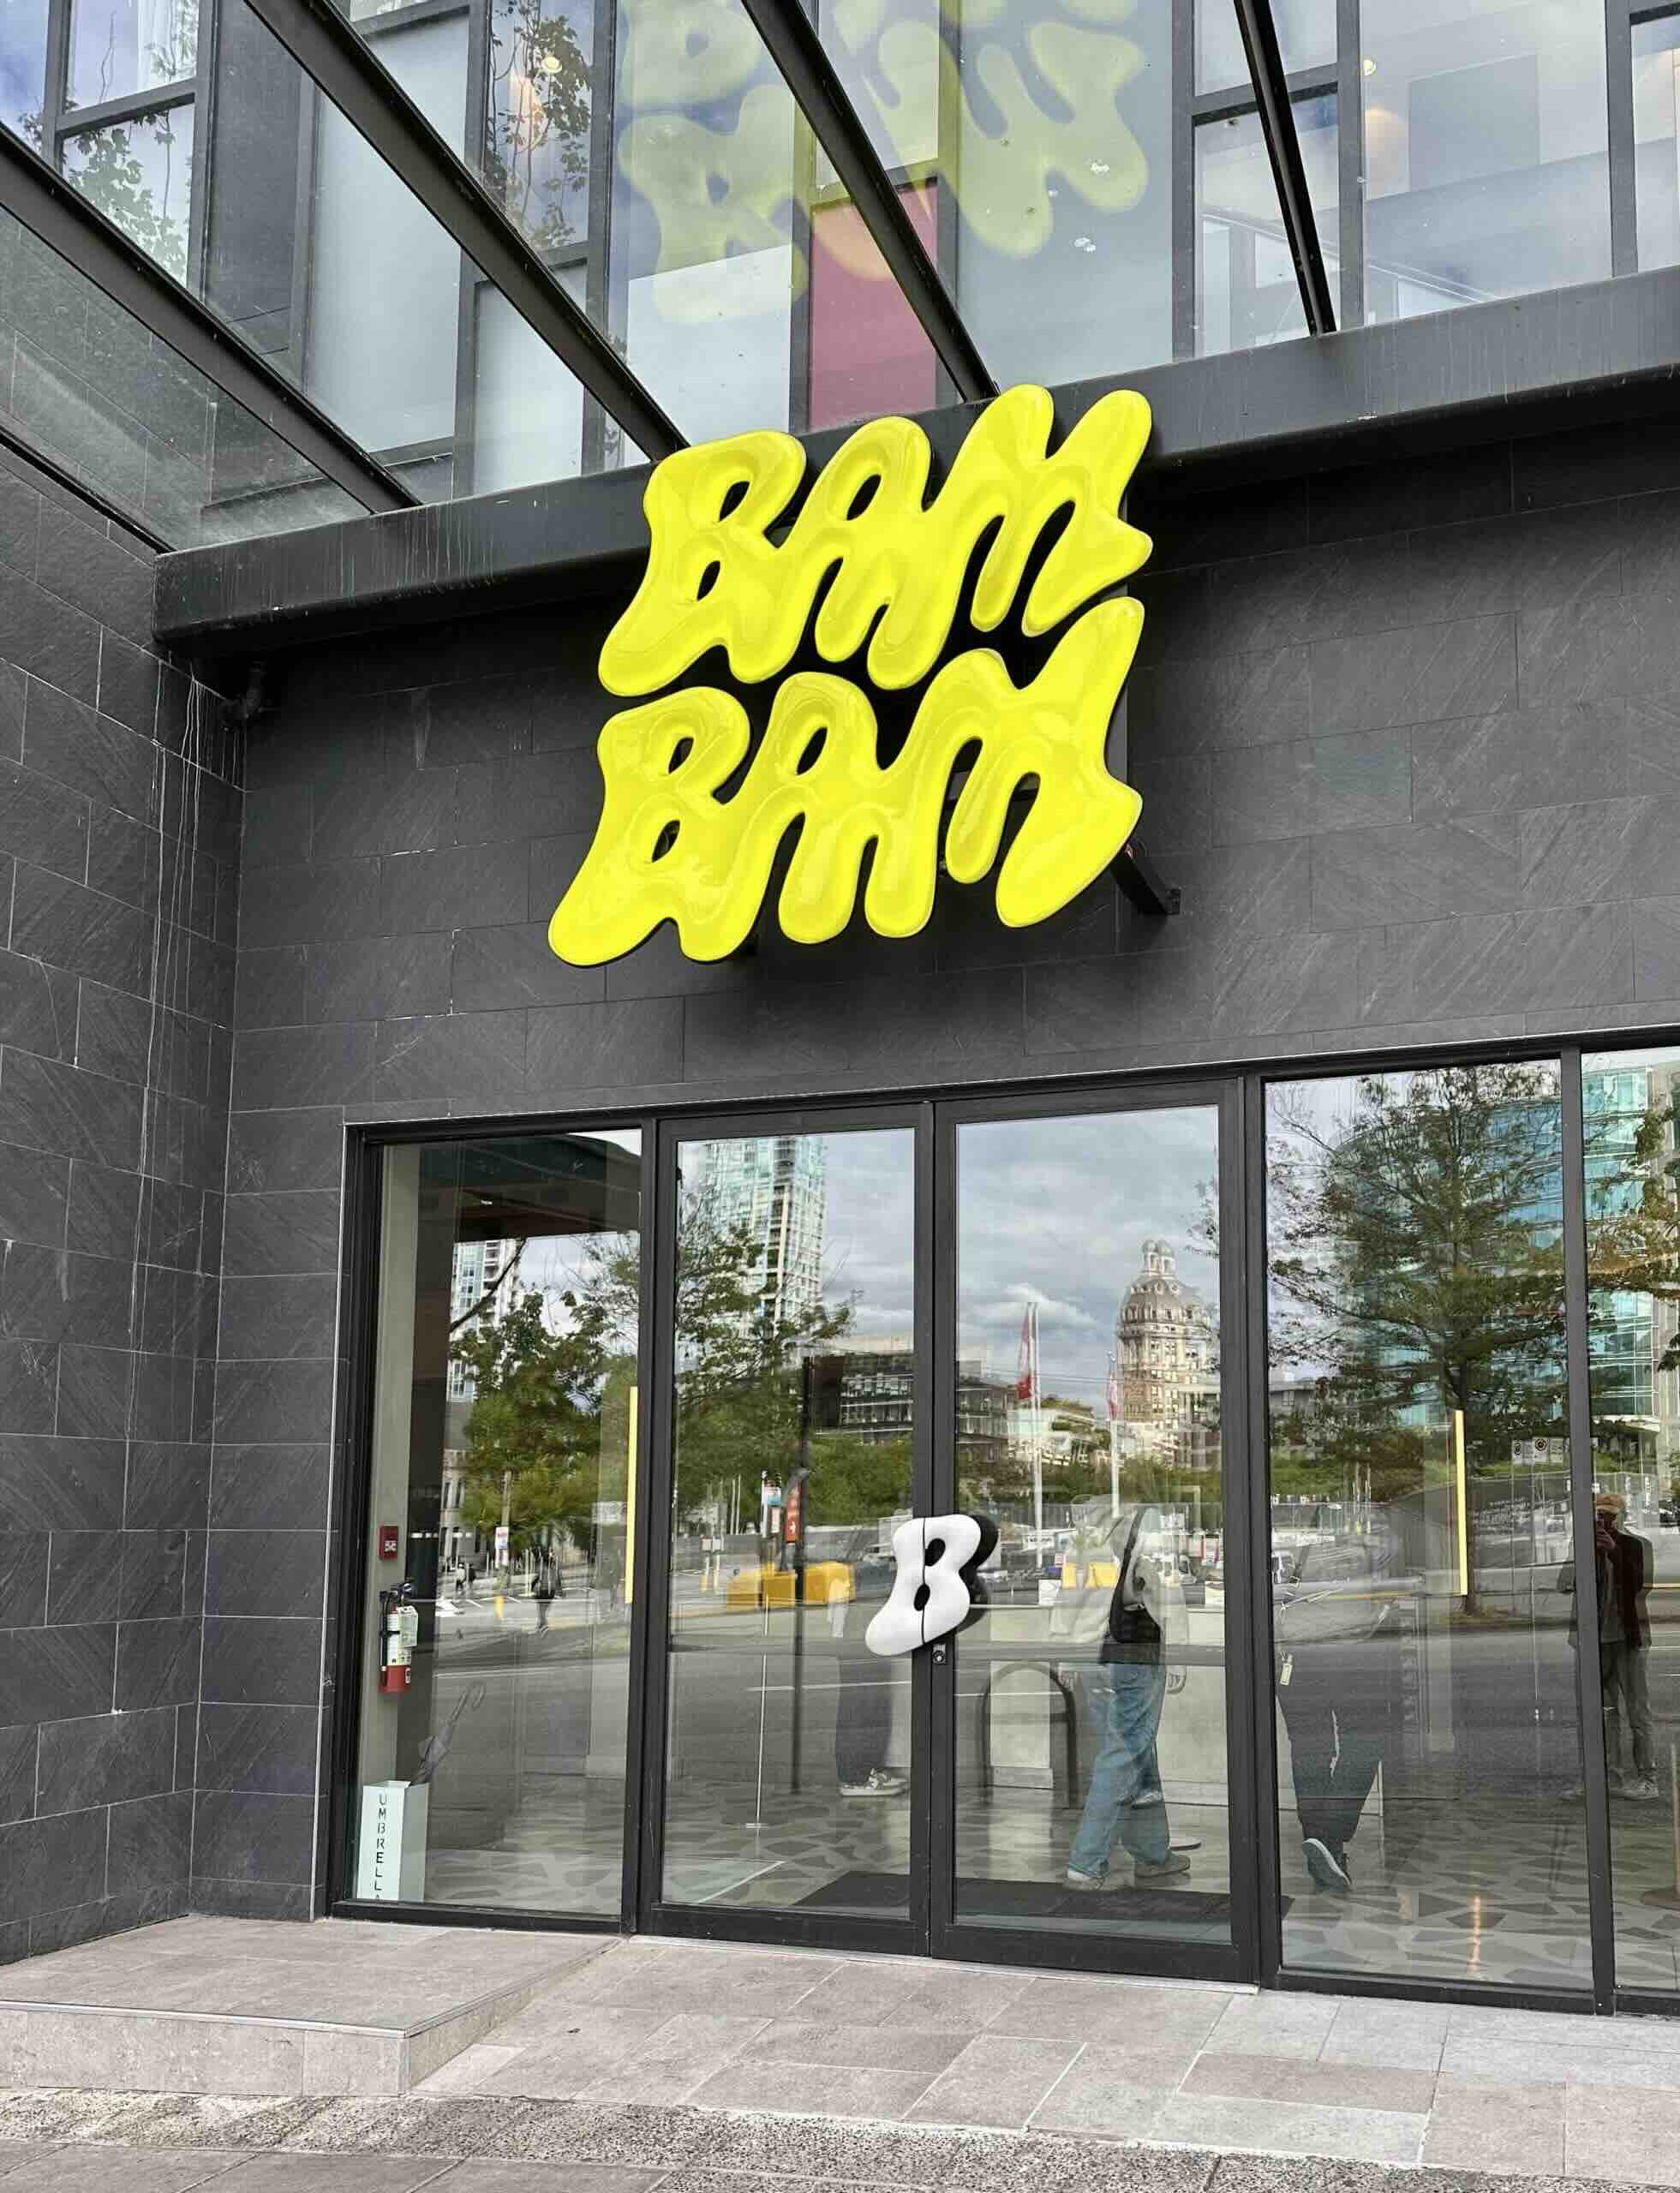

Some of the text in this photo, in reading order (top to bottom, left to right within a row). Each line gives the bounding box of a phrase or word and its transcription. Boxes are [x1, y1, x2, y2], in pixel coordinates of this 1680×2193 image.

[598, 384, 1153, 697] BAM
[548, 596, 1143, 967] BAM
[864, 1514, 982, 1657] B
